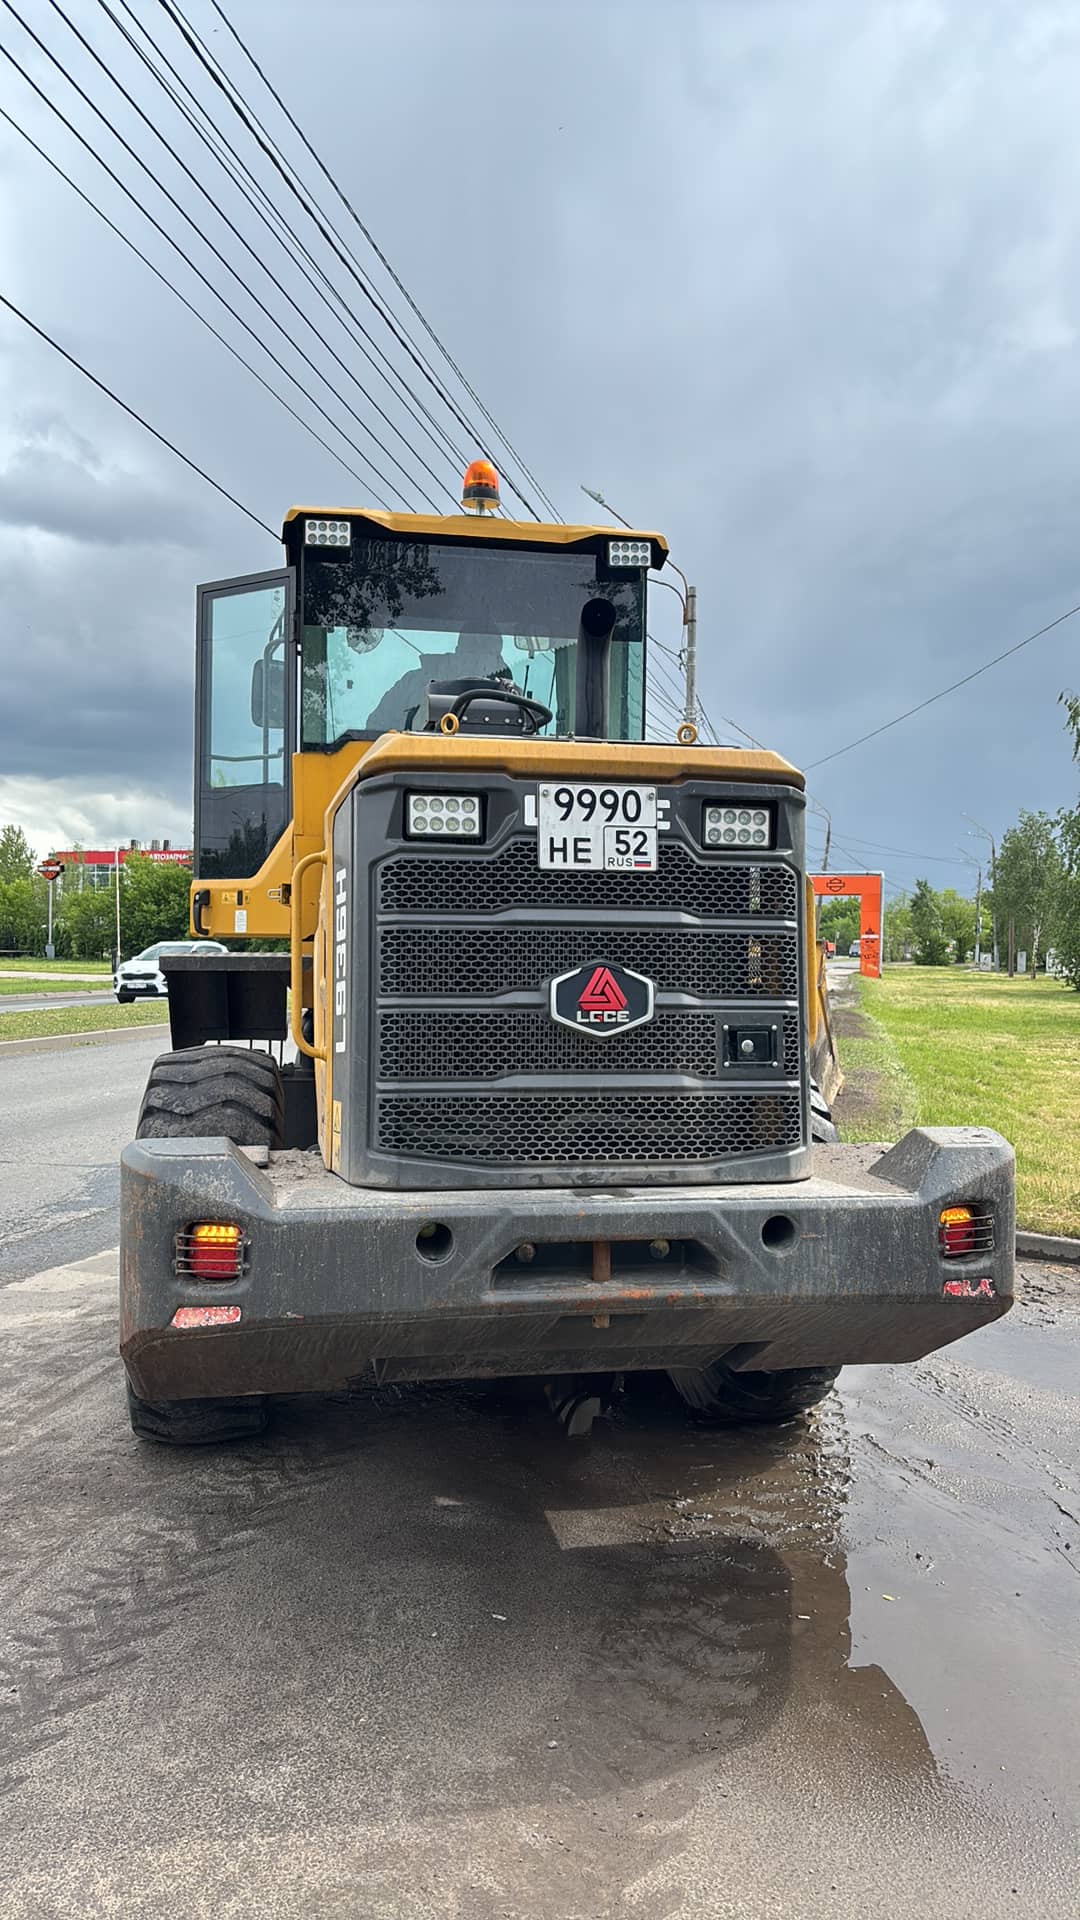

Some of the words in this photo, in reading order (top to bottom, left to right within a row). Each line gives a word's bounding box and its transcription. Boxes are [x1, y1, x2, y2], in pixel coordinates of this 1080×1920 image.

[524, 795, 671, 830] LE
[554, 787, 642, 823] 9990
[615, 830, 648, 856] 52
[607, 857, 633, 867] RUS
[335, 867, 347, 1053] L936H
[576, 1010, 630, 1023] LGCE
